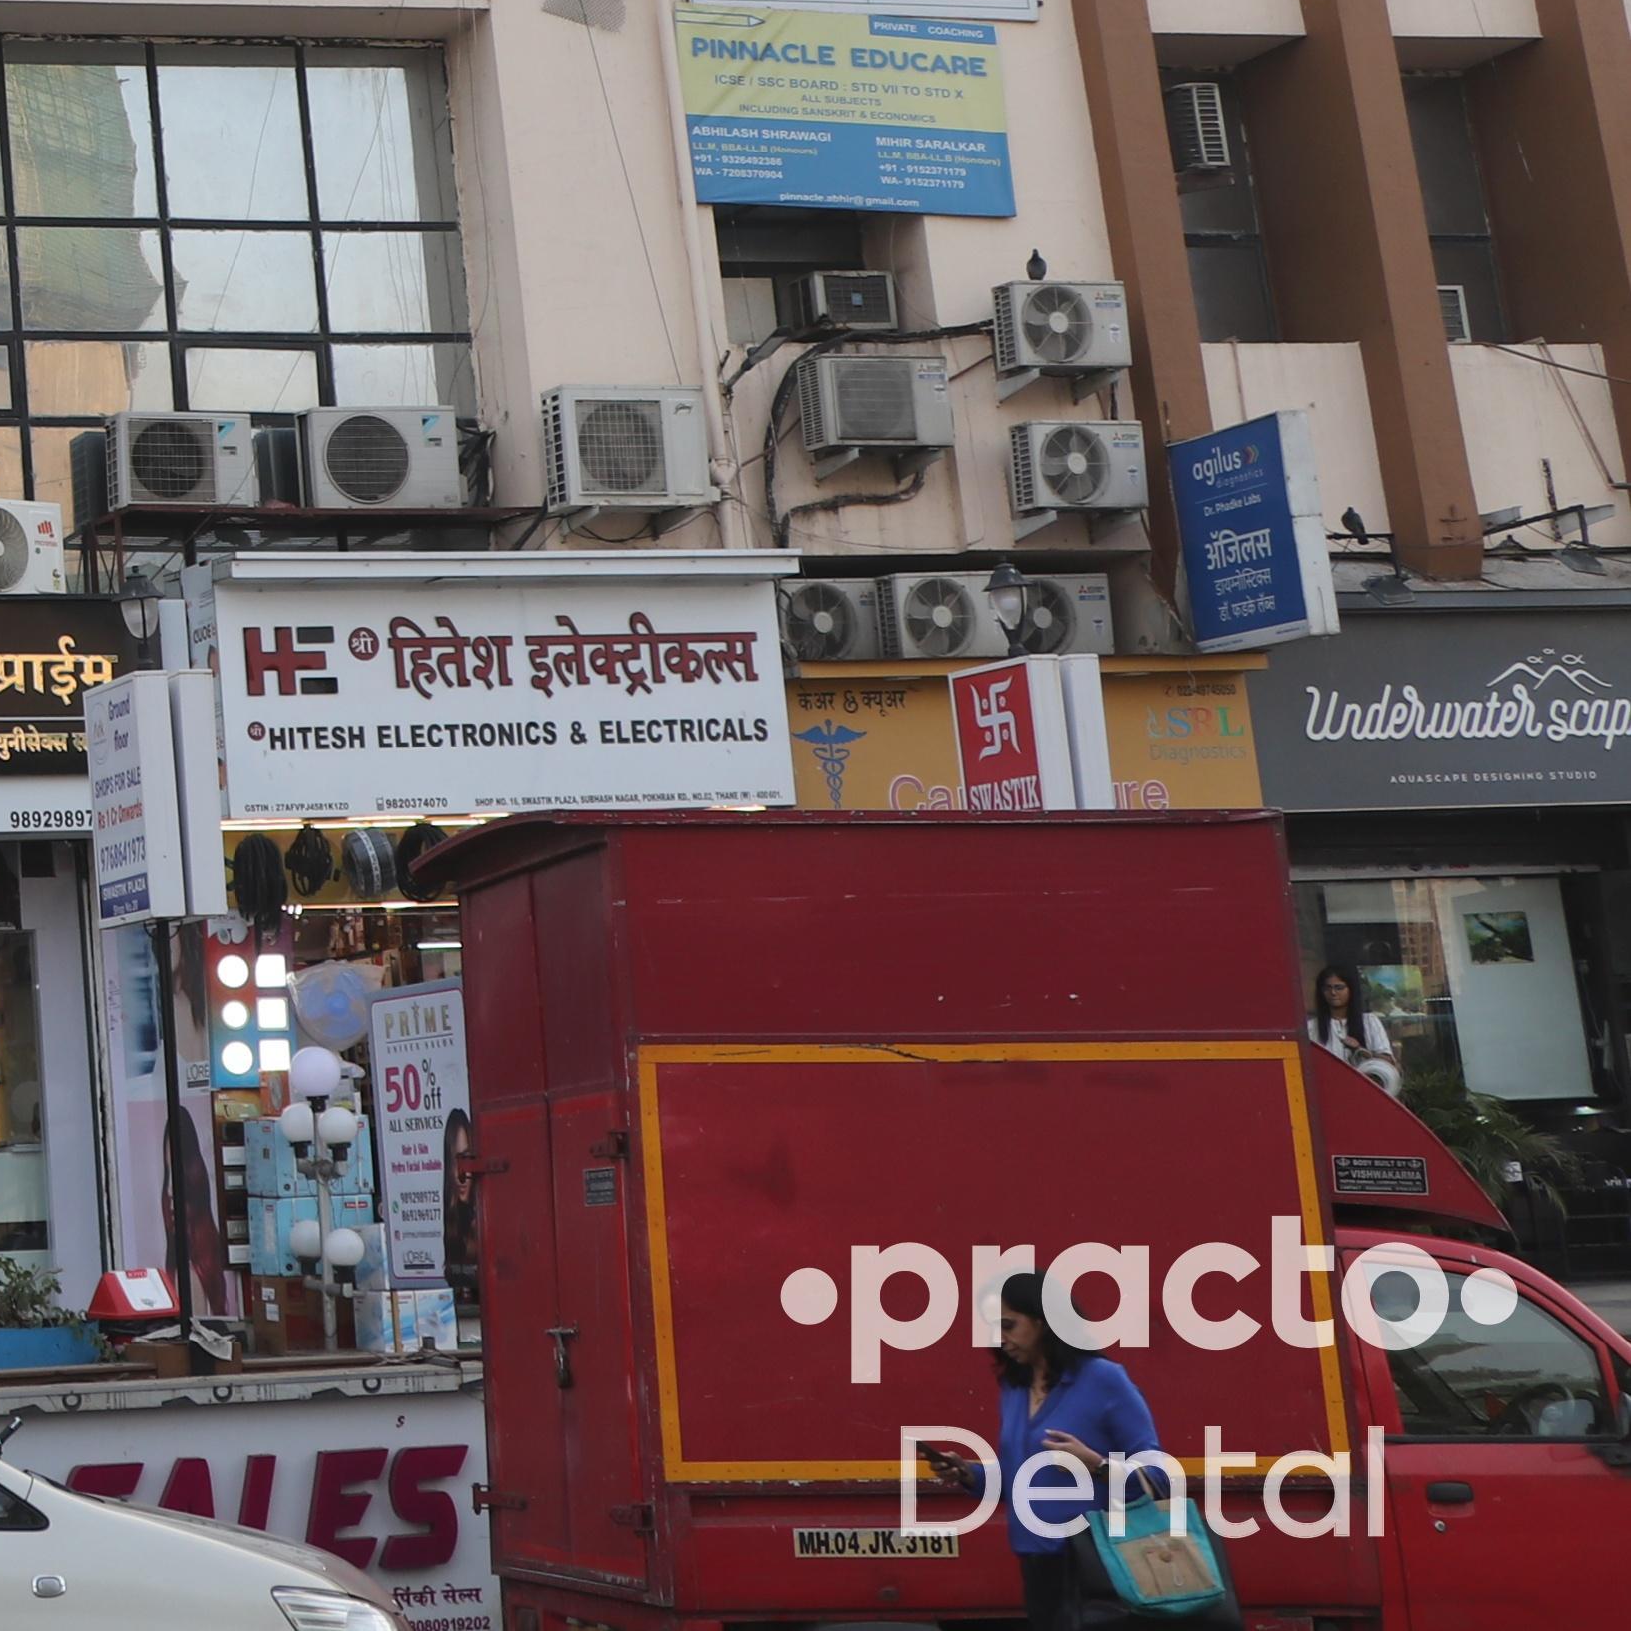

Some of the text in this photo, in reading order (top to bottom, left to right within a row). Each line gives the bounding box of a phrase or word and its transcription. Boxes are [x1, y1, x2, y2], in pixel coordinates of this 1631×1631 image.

[927, 26, 984, 39] COACHING
[691, 37, 987, 77] PINNACLE EDUCARE
[715, 74, 951, 98] ICSE SSC BOARD STD TO STD
[739, 104, 799, 115] INCLUDING
[801, 94, 882, 106] ALL SUBJECTS
[692, 126, 832, 142] ABHILASH SHRAWAGI
[876, 137, 986, 152] MIHIR SARALKAR
[1192, 446, 1242, 486] agilus
[1215, 493, 1262, 514] Phadke Labs
[388, 616, 513, 699] हितेश
[1305, 683, 1543, 742] Underwater
[113, 730, 129, 753] floor
[269, 718, 769, 750] HITESH ELECTRONICS & ELECTRICALS
[95, 766, 142, 799] SHOPS FOR SALE
[1390, 770, 1597, 784] AQUASCAPE DESIGNING STUDIO
[522, 796, 553, 806] SWASTIK
[970, 776, 1041, 811] SWASTIK
[244, 798, 447, 813] GSTIN 9820374070
[385, 1001, 452, 1039] PRIME
[385, 1058, 435, 1114] 50 %
[423, 1087, 442, 1111] off
[389, 1116, 443, 1133] ALL SERVICES
[1350, 1170, 1422, 1179] VISHWAKARMA
